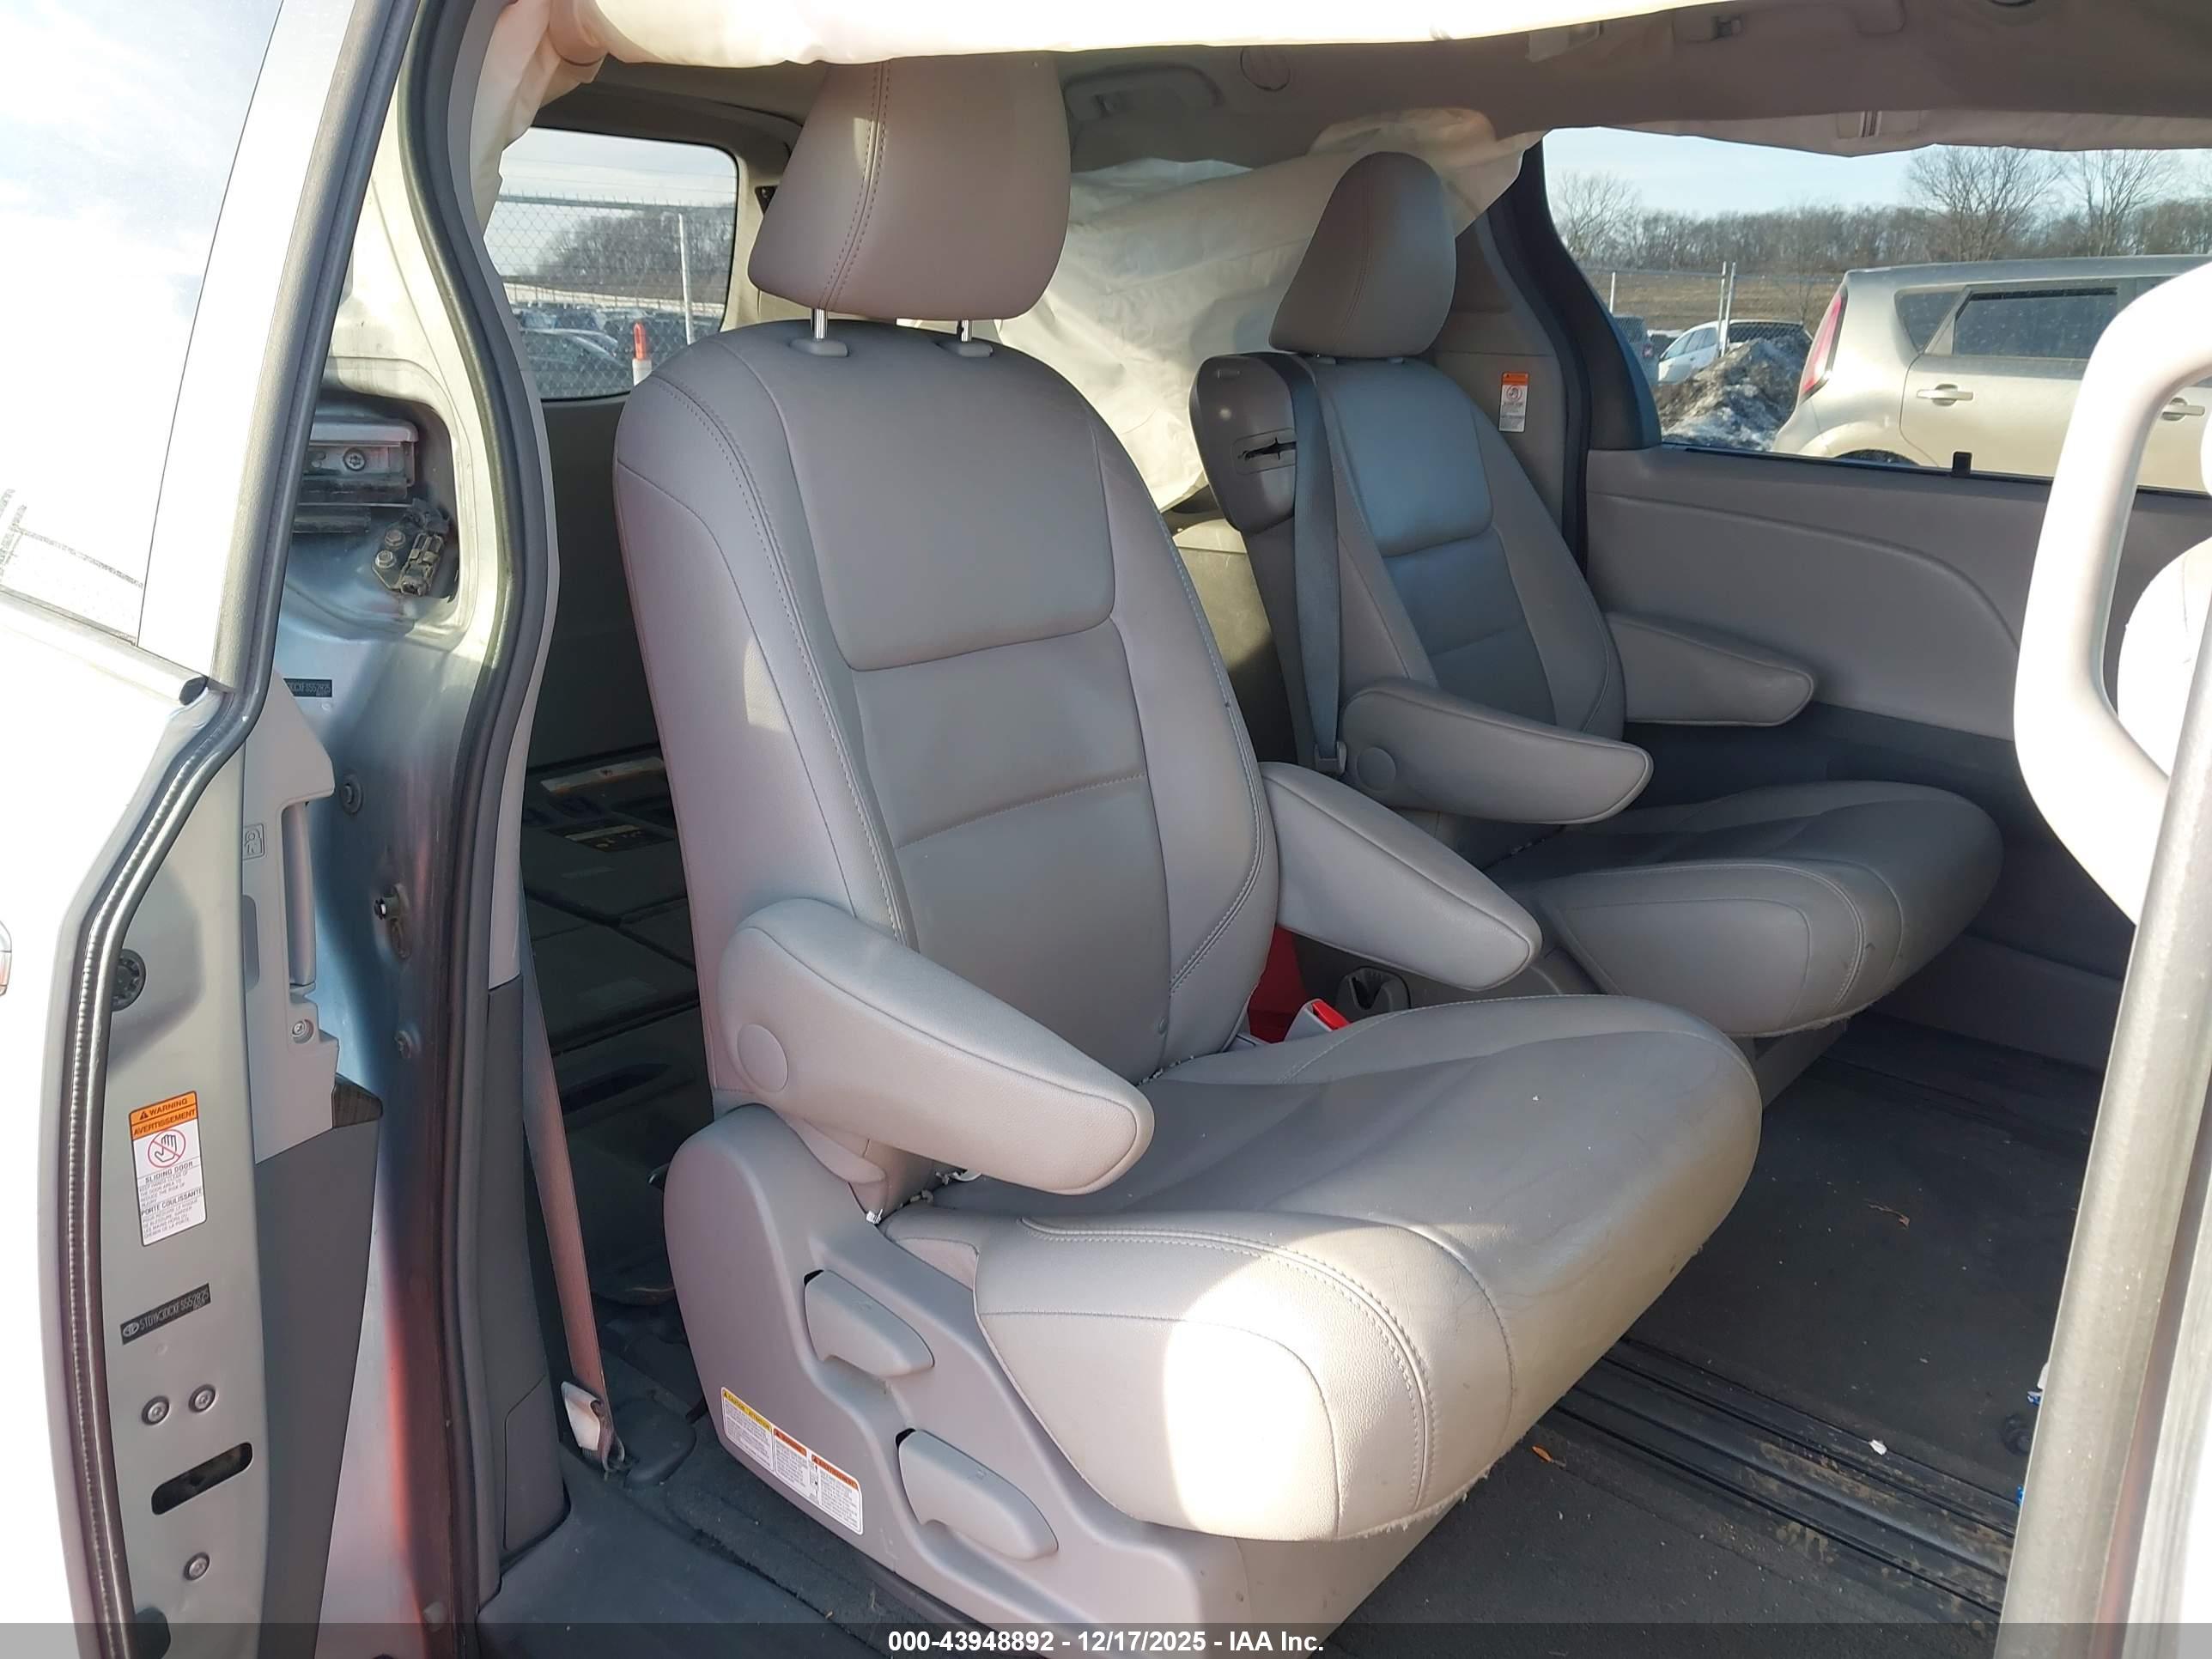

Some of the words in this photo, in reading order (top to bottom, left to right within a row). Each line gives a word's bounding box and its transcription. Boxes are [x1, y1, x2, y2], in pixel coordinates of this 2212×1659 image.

[149, 1098, 188, 1116] WARNING
[133, 1109, 196, 1136] AVERTISSEMENT
[144, 1168, 172, 1183] SLIDING
[173, 1160, 193, 1173] DOOR
[140, 1202, 160, 1217] PORTE
[161, 1187, 202, 1209] COULISSANTE
